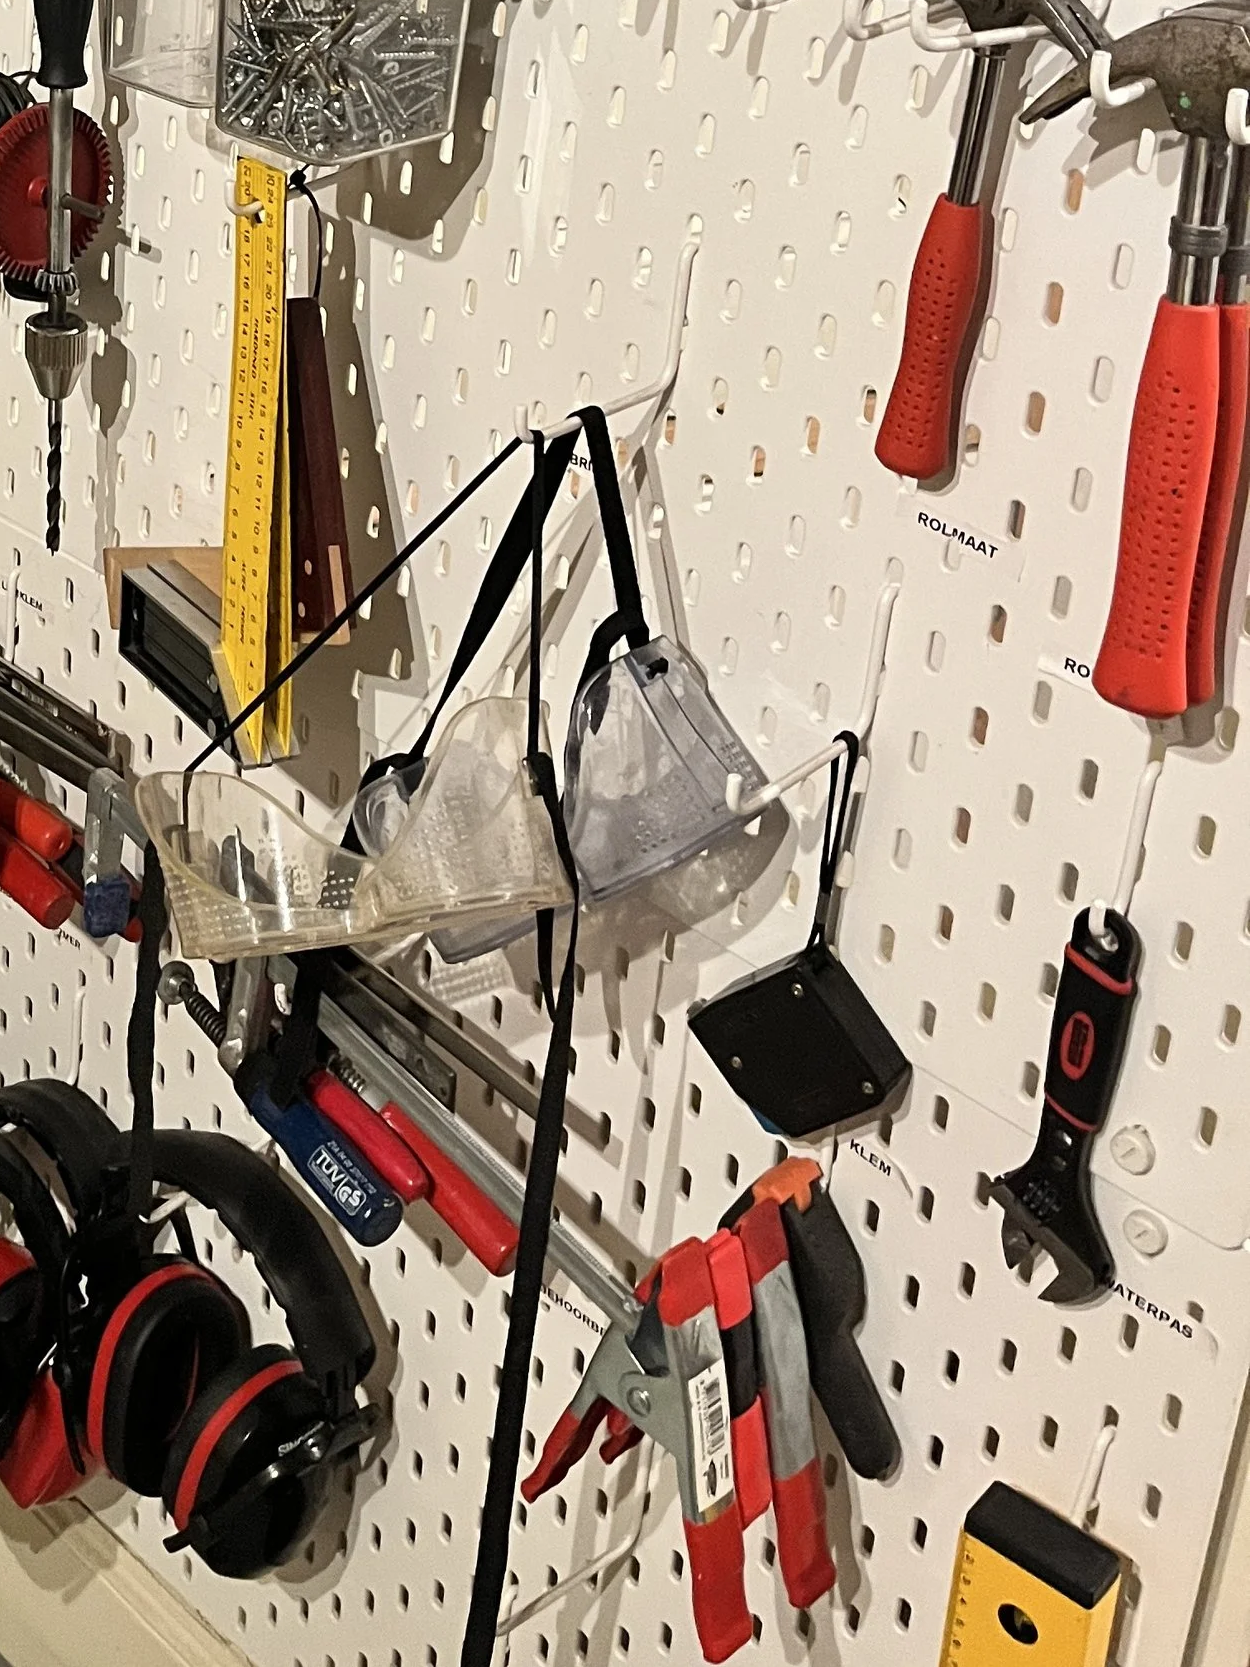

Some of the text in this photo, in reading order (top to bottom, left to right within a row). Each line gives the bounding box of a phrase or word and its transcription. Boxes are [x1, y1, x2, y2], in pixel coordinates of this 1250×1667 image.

[917, 511, 999, 559] ROLMAAT
[850, 1137, 891, 1177] KLEM
[338, 1186, 362, 1207] GS
